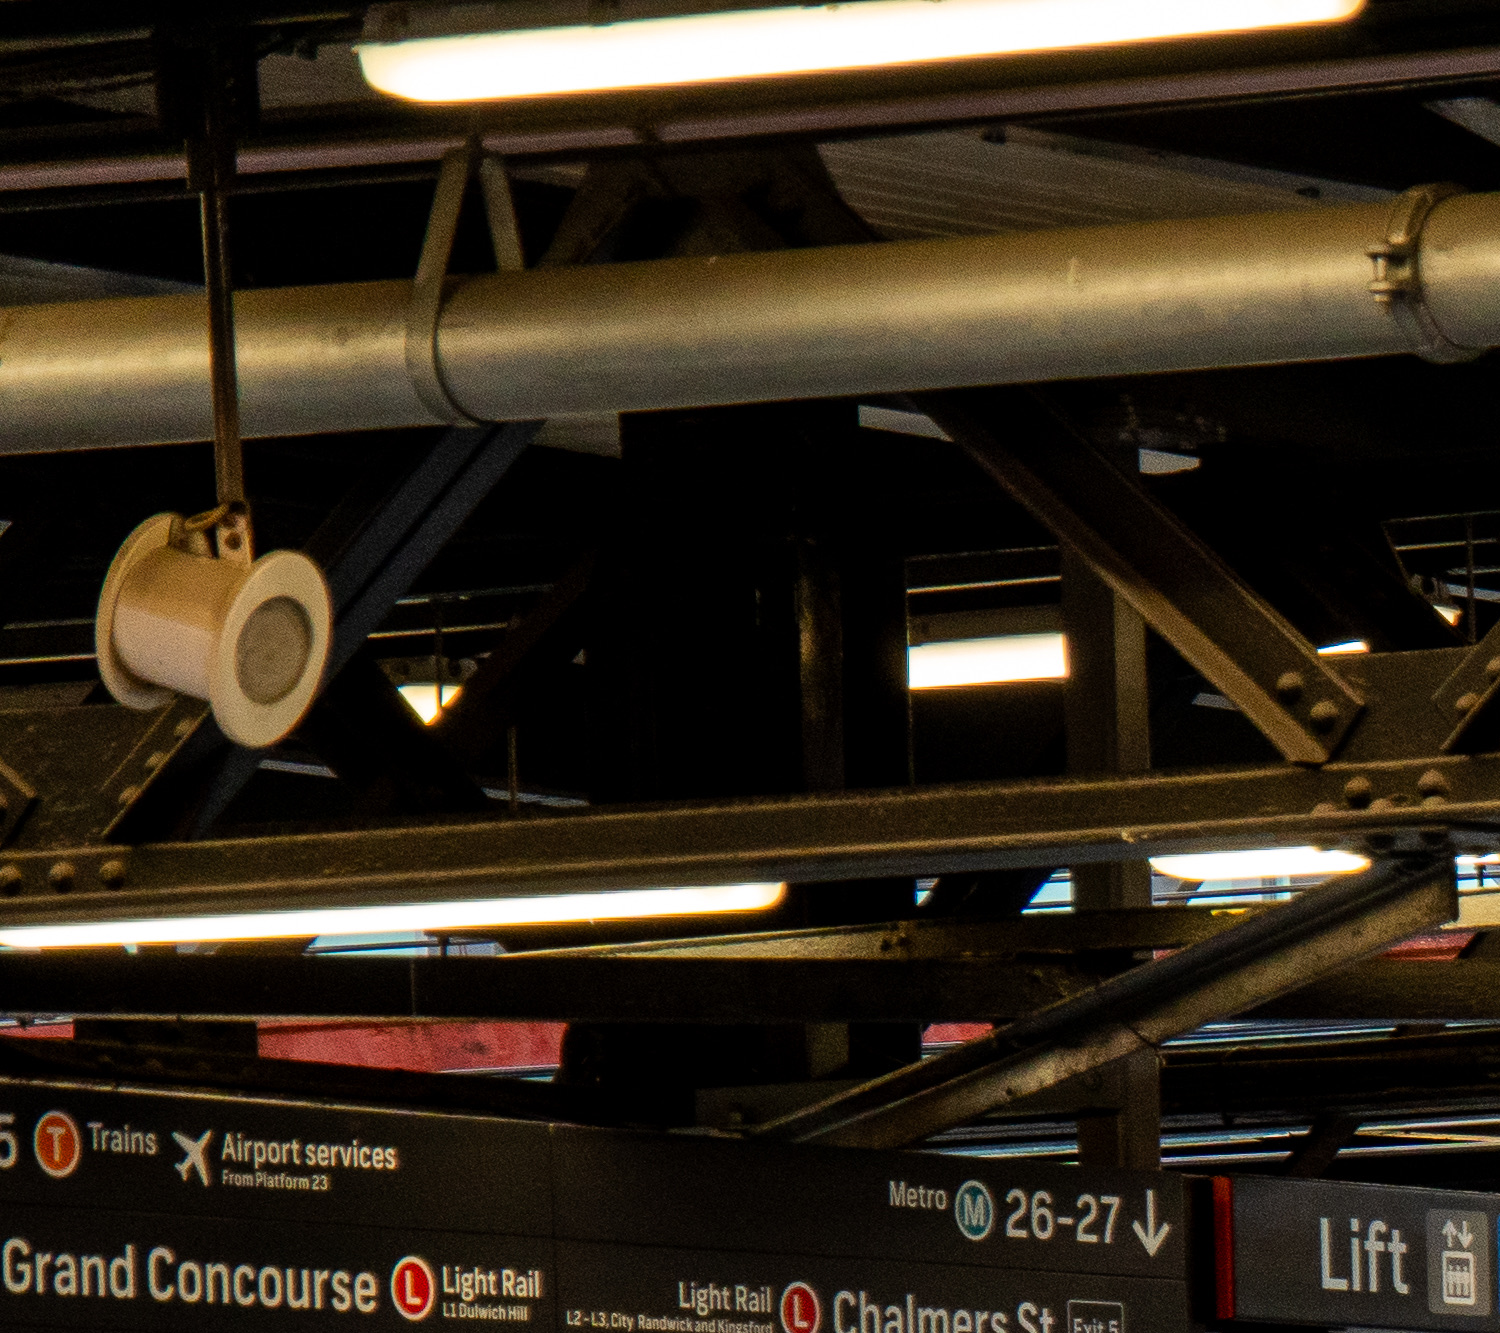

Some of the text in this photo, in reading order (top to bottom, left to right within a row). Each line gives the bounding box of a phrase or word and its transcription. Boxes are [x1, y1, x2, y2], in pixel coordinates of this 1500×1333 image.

[87, 1122, 159, 1156] Trains
[221, 1131, 301, 1172] Airport
[304, 1139, 398, 1171] services
[222, 1170, 329, 1191] From Platform 23
[889, 1180, 948, 1212] Metro
[1005, 1189, 1122, 1244] 26-27
[2, 1238, 136, 1299] Grand
[148, 1246, 378, 1312] Concourse
[441, 1266, 498, 1301] Light
[501, 1270, 542, 1299] Rail
[1319, 1216, 1410, 1295] Lift
[442, 1304, 529, 1322] L1 Dulwich Hill
[679, 1281, 730, 1315] Light
[735, 1286, 772, 1314] Rail
[611, 1313, 633, 1331] City
[638, 1315, 693, 1333] Randwick
[695, 1320, 716, 1333] and
